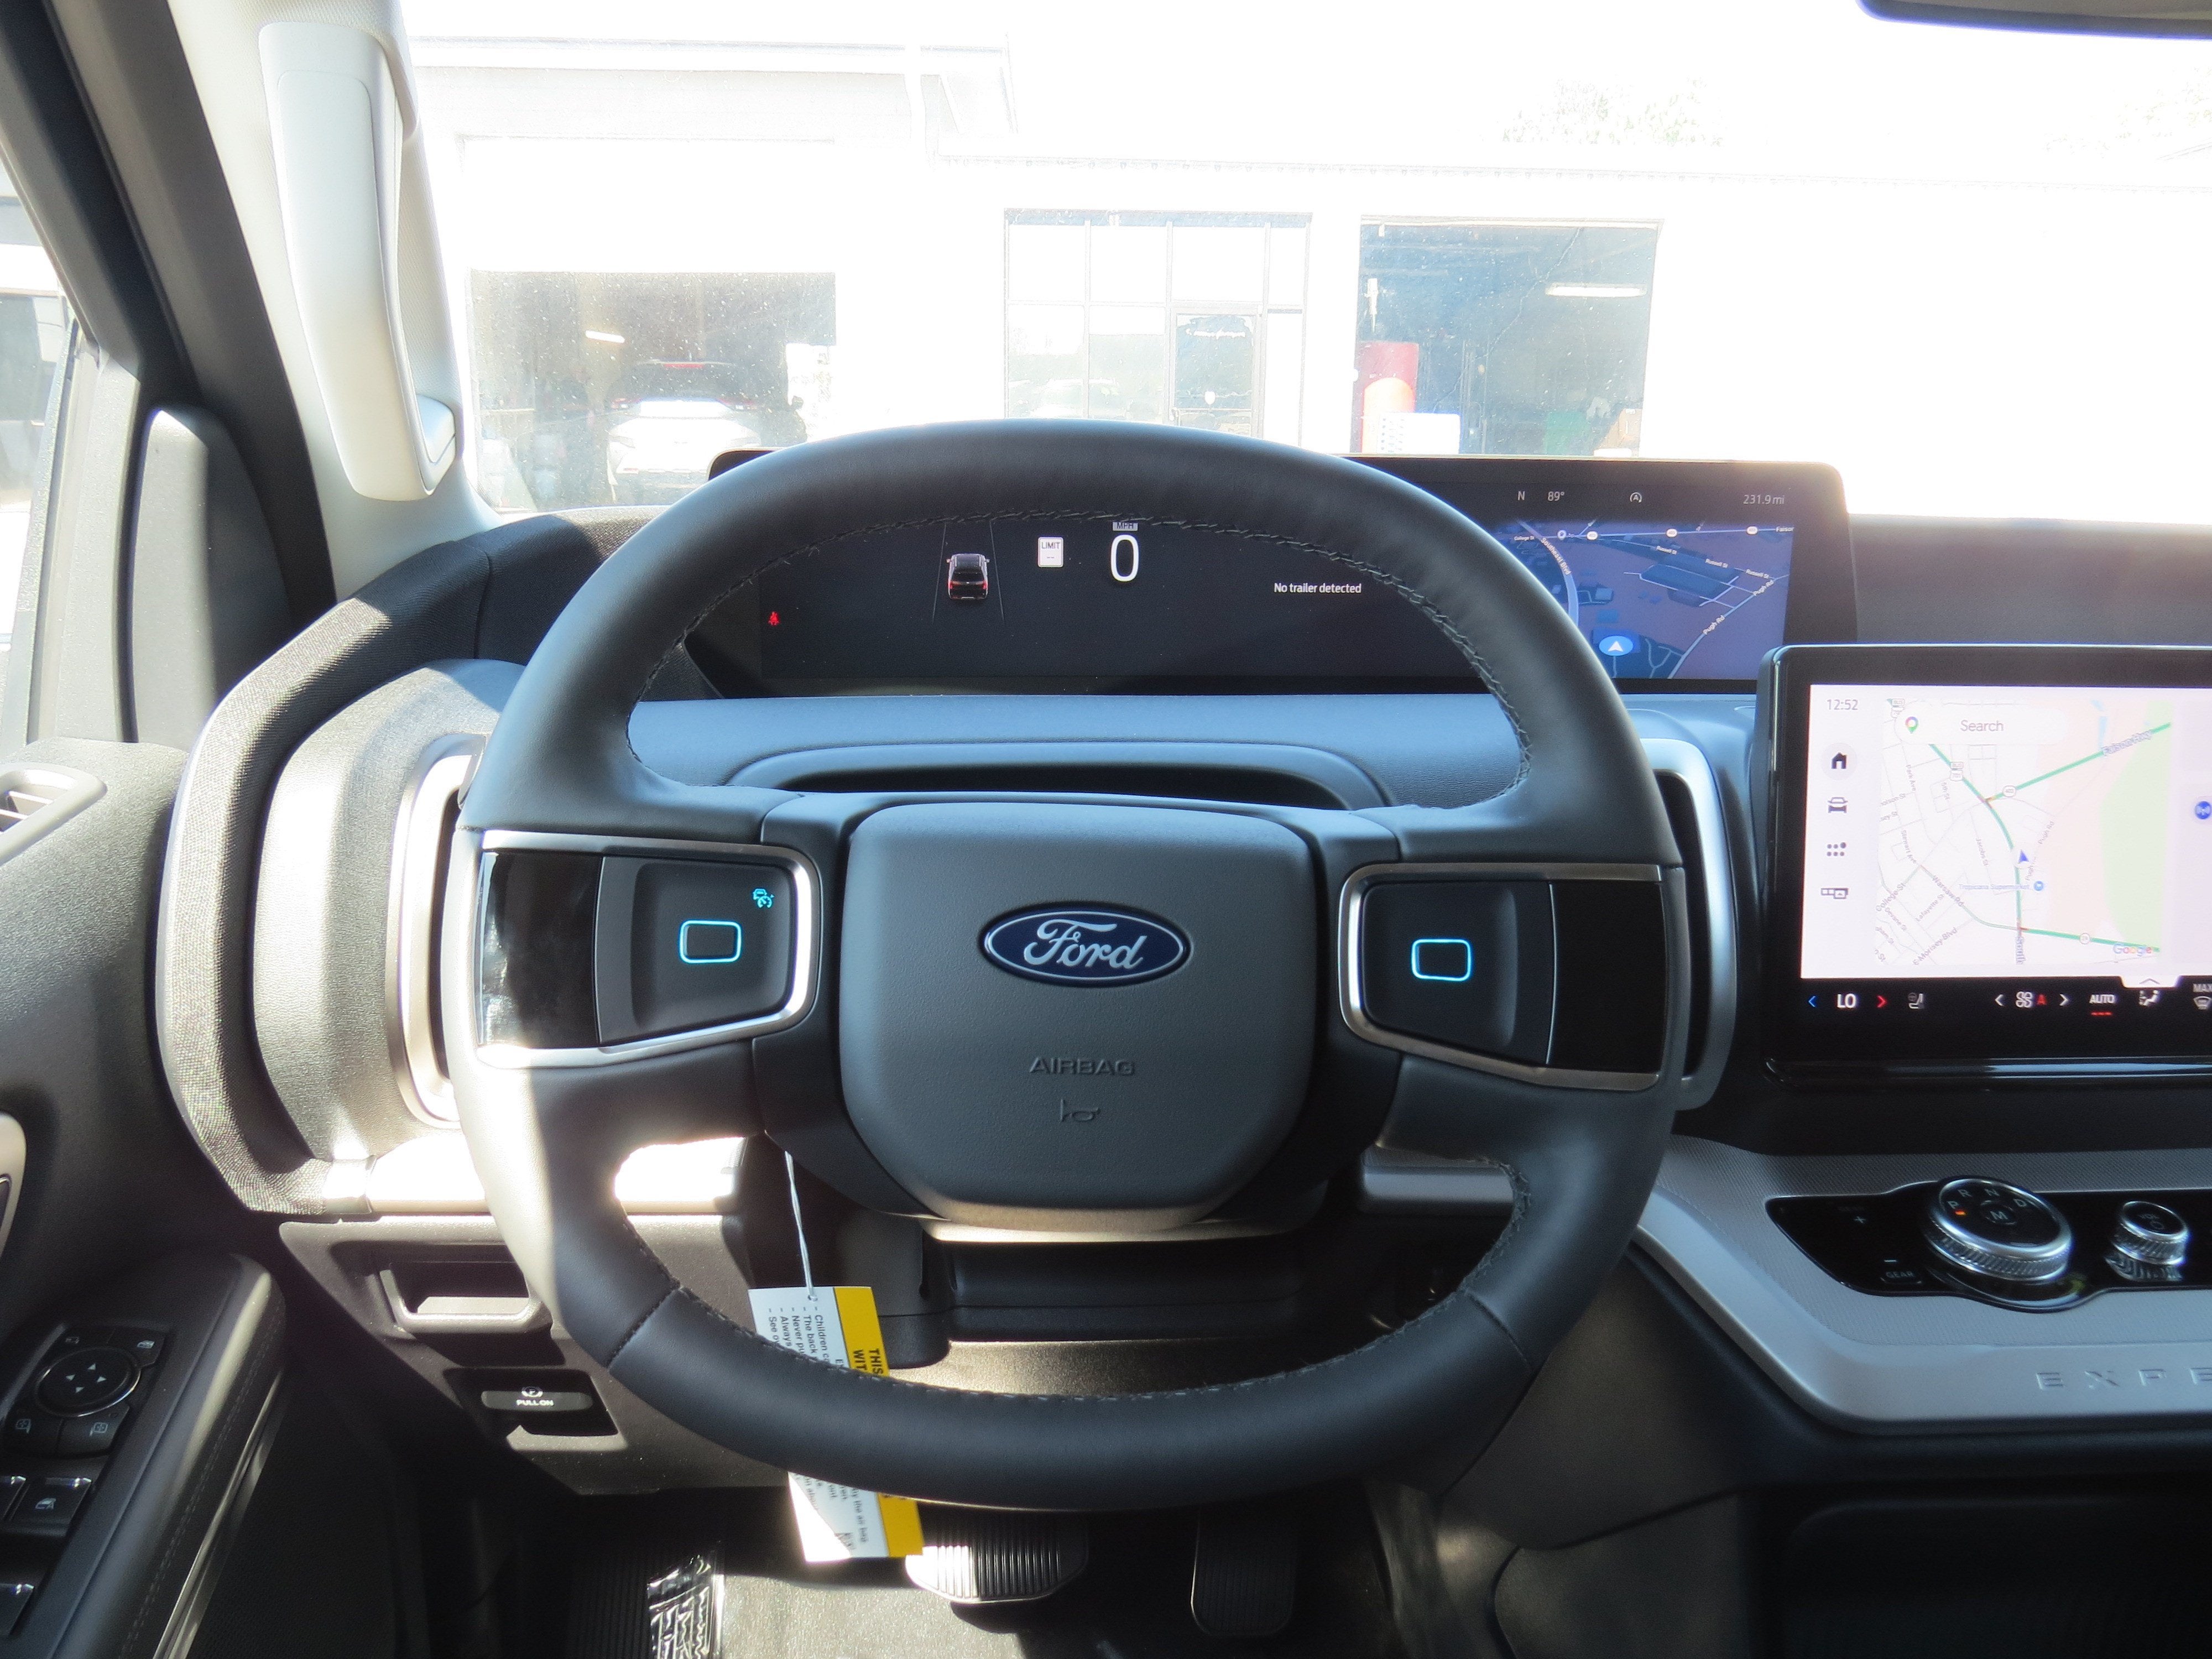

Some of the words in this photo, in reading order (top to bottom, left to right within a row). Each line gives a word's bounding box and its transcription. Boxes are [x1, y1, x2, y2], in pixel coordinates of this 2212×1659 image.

[1517, 491, 1525, 500] N
[1547, 491, 1565, 502] 89°
[1110, 534, 1139, 582] 0
[1540, 537, 1563, 562] Southeast
[1559, 561, 1572, 575] Blvd
[1274, 582, 1287, 593] No
[1289, 582, 1318, 593] trailer
[1319, 582, 1362, 593] detected
[1753, 585, 1767, 596] Pugh
[1766, 579, 1774, 588] Rd
[1703, 622, 1717, 635] Pugh
[1716, 614, 1725, 624] Rd
[1827, 699, 1859, 711] 12:52
[1960, 719, 2004, 732] Search
[2037, 830, 2049, 845] Pugh
[2046, 821, 2055, 831] Rd
[1901, 830, 1911, 854] Stewart
[1907, 854, 1917, 864] Ave
[1875, 889, 1898, 912] College
[1896, 881, 1906, 892] St
[1932, 875, 1956, 900] Warsaw
[1954, 896, 1965, 907] Rd
[1914, 899, 1939, 922] Lafayette
[1942, 926, 1958, 941] Blvd
[1024, 918, 1147, 969] Ford
[2193, 983, 2212, 993] MAX
[1837, 993, 1857, 1008] LO
[2089, 994, 2115, 1004] AUTO
[1029, 1057, 1136, 1076] AIRBAG
[1958, 1189, 1973, 1197] R
[1947, 1201, 1959, 1209] P
[2013, 1198, 2027, 1207] D
[1990, 1211, 2008, 1220] M
[768, 1316, 778, 1333] See
[780, 1316, 792, 1347] Always
[792, 1315, 802, 1342] Never
[803, 1315, 812, 1332] The
[814, 1314, 828, 1354] Children
[807, 1333, 818, 1354] back
[868, 1348, 884, 1375] THIS
[2036, 1366, 2212, 1390] EXPE
